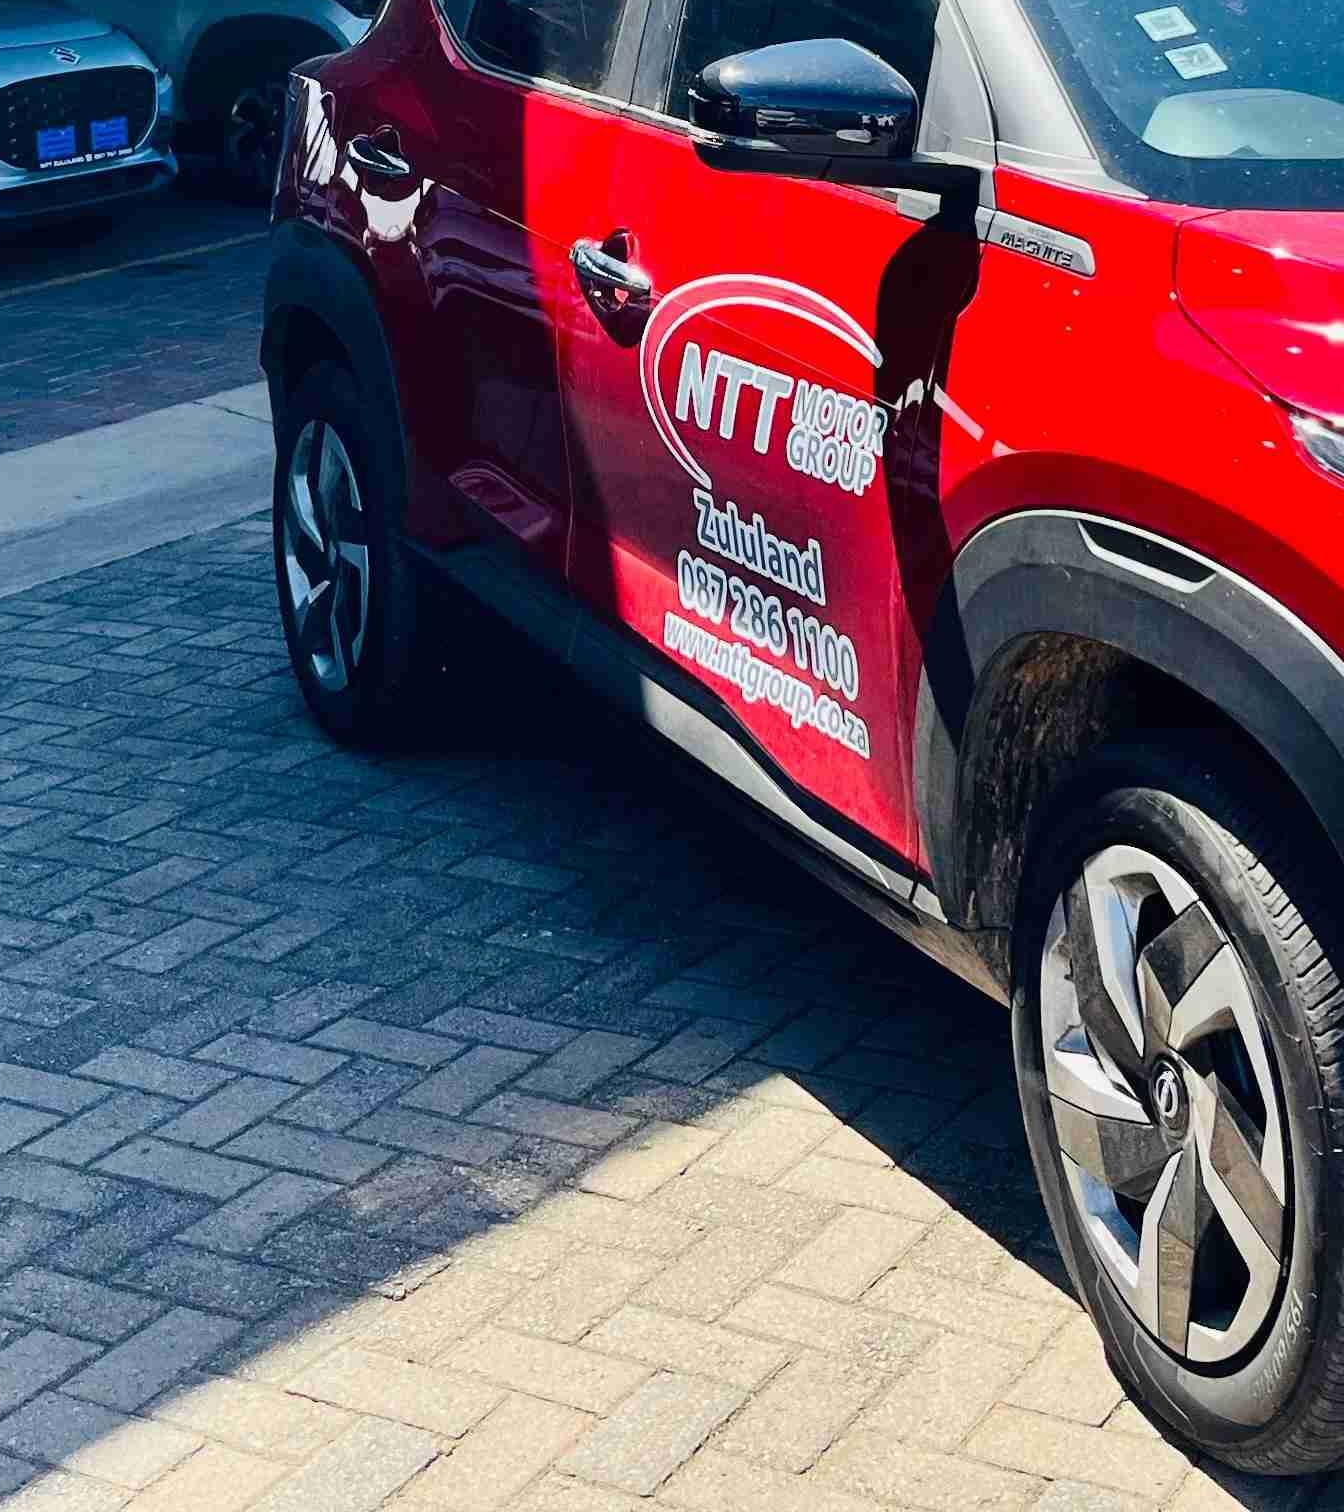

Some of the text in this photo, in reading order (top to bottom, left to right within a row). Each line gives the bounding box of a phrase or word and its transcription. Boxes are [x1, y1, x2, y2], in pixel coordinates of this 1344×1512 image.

[676, 341, 794, 455] NTT
[792, 379, 888, 456] MOTOR
[787, 426, 876, 497] GROUP
[694, 488, 826, 606] Zululand
[678, 550, 859, 701] 087 286 1100
[664, 612, 870, 759] www.nttgroup.co.za
